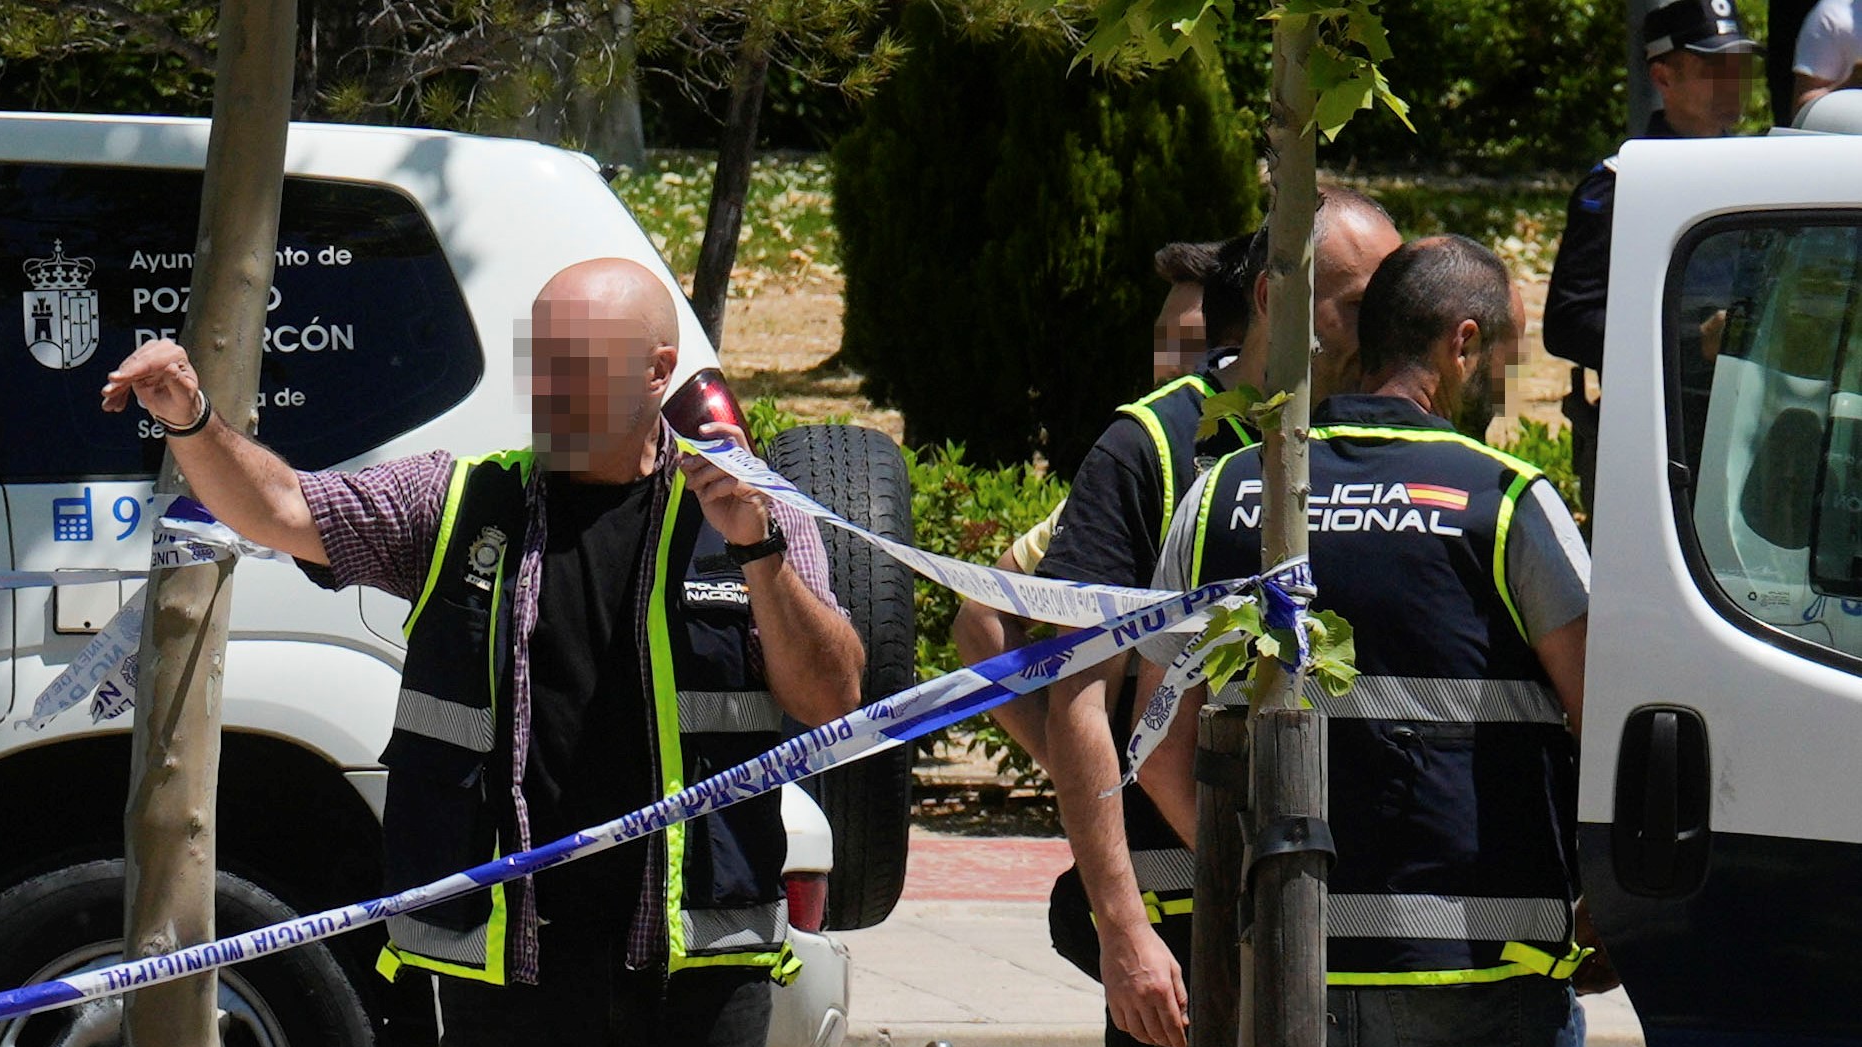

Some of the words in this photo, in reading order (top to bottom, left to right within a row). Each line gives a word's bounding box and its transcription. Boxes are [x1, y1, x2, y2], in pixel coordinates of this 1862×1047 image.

[130, 246, 309, 273] Ayunnto
[318, 245, 353, 266] de
[263, 316, 355, 353] RCÓN
[274, 388, 306, 407] de
[1230, 506, 1463, 537] NCIONAL
[686, 590, 750, 605] NACIONA
